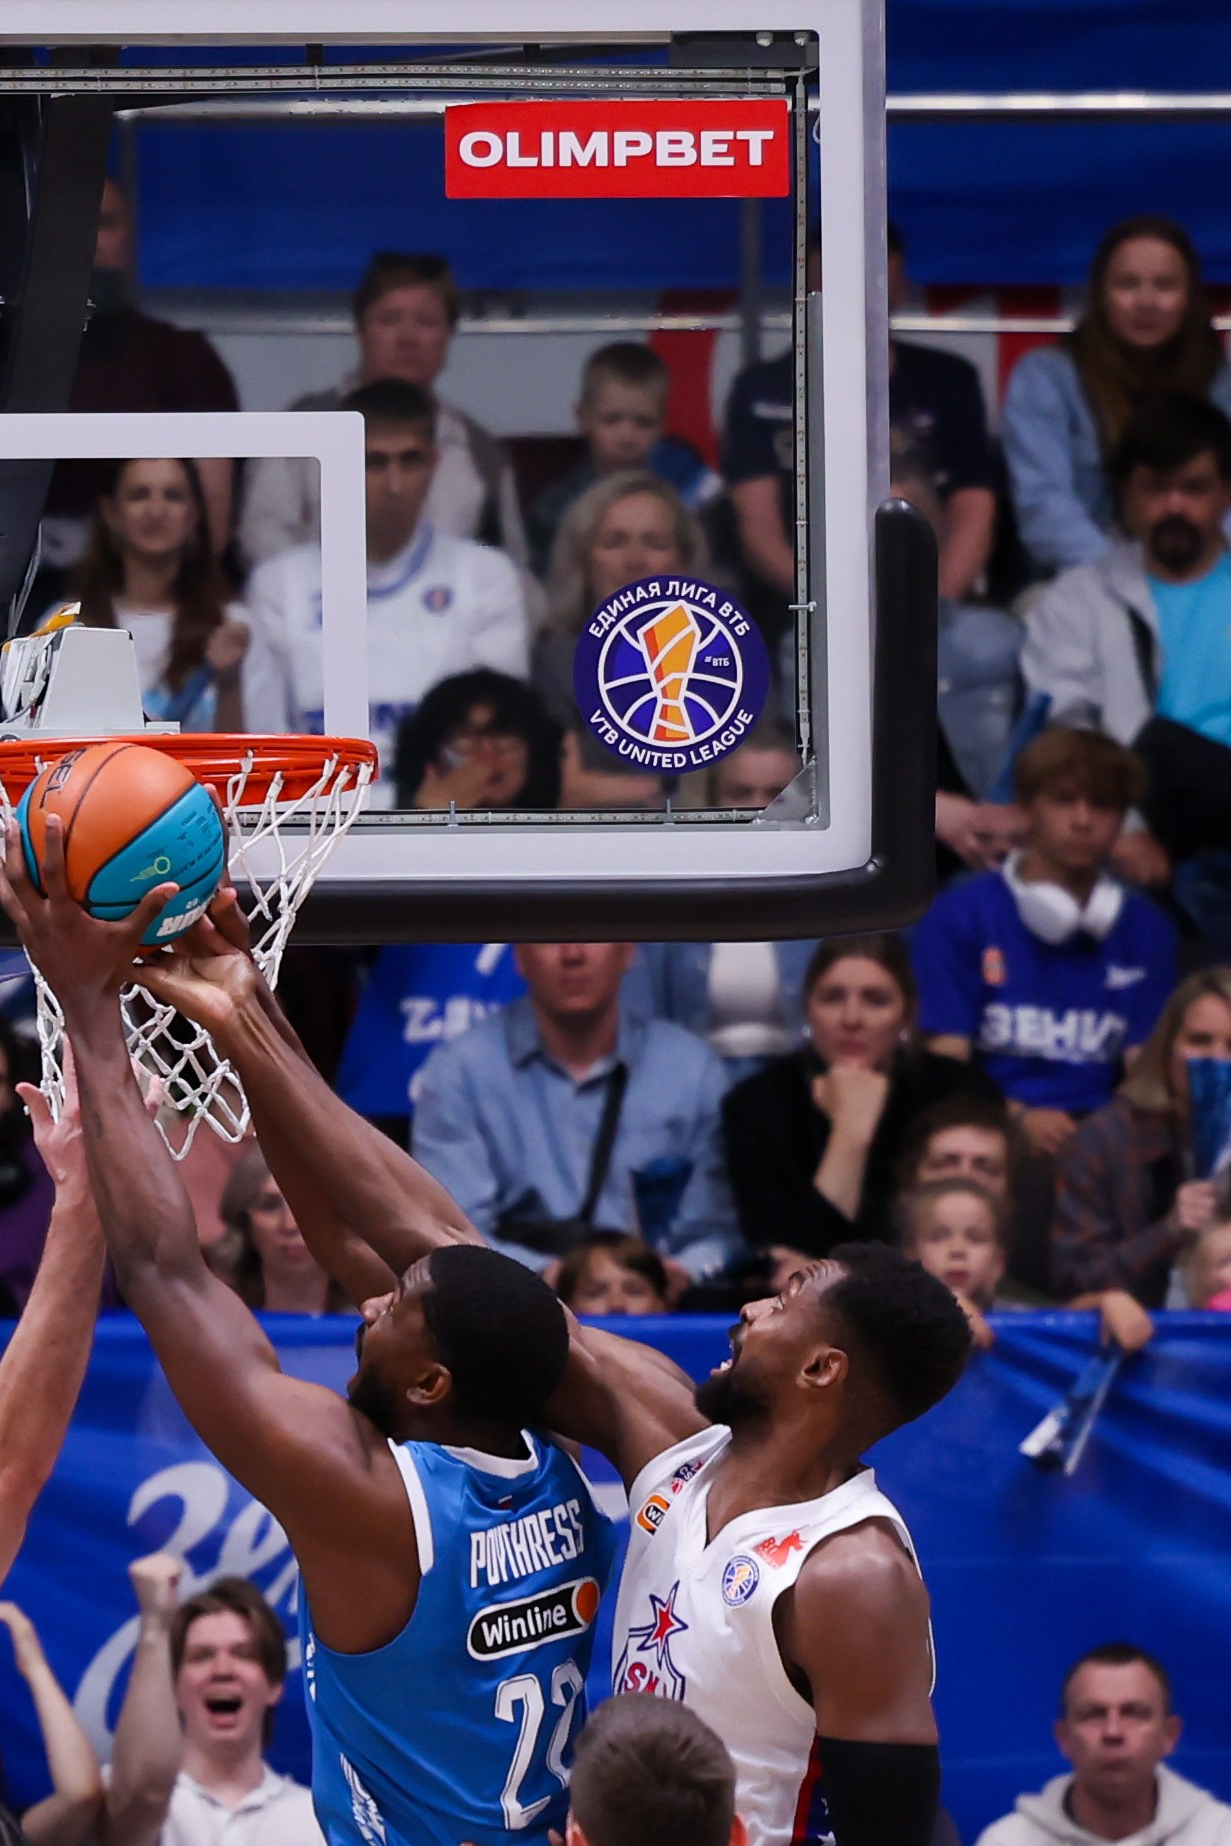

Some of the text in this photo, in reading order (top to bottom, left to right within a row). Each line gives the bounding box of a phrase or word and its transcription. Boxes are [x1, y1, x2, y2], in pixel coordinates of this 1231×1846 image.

[458, 130, 774, 167] OLIMPBET
[588, 580, 751, 638] ЕДИНАЯ ЛИГА ВТБ
[589, 709, 754, 768] VTB UNITED LEAGUE
[481, 1604, 568, 1648] Winline
